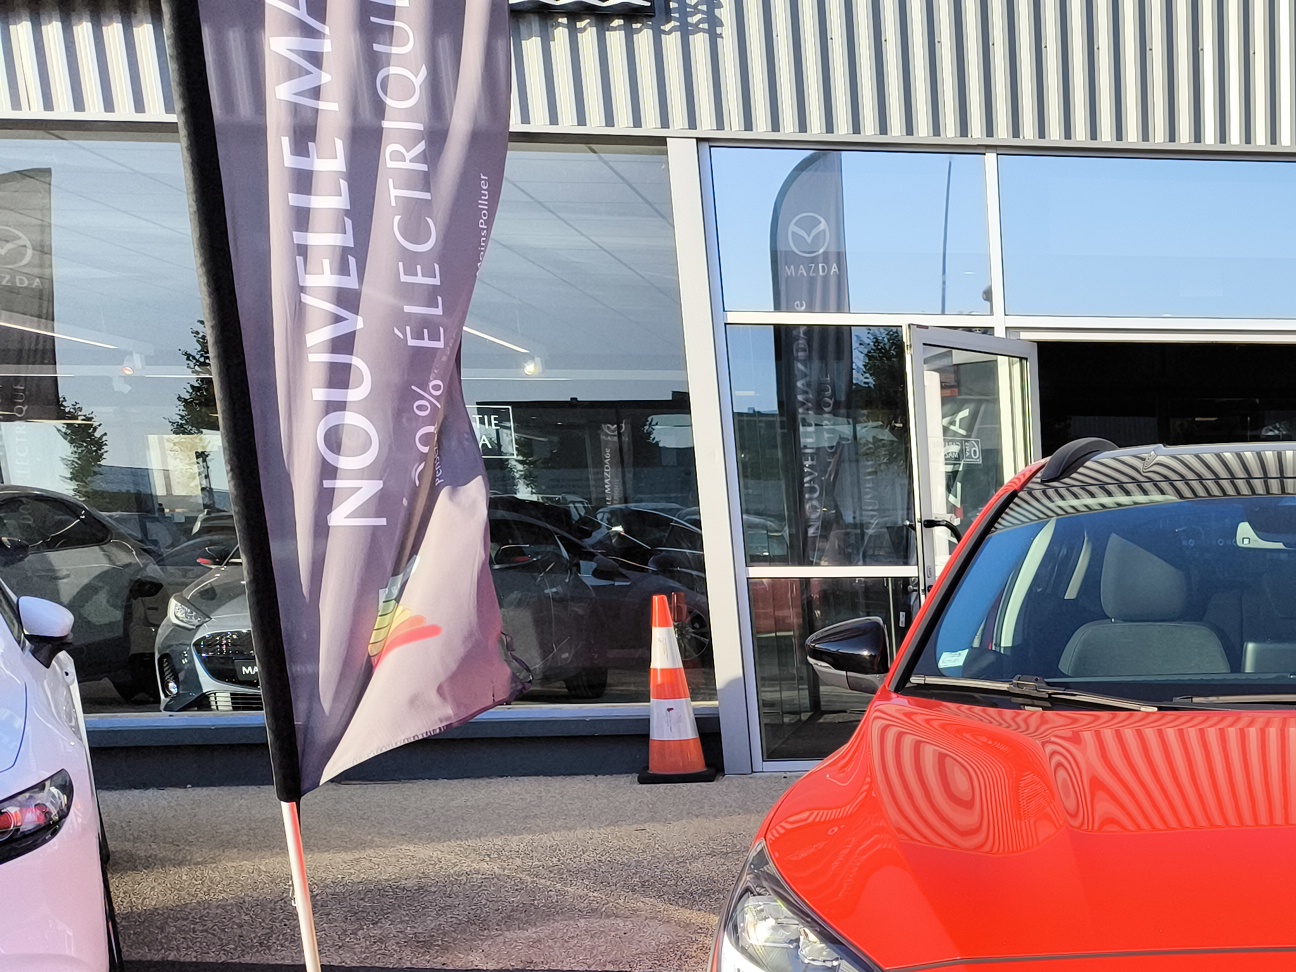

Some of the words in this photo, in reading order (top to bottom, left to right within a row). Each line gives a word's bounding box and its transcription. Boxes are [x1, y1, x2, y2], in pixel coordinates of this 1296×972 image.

[281, 136, 388, 526] NOUVELLE
[370, 0, 445, 348] ÉLECTRIQU
[784, 263, 840, 277] MAZDA
